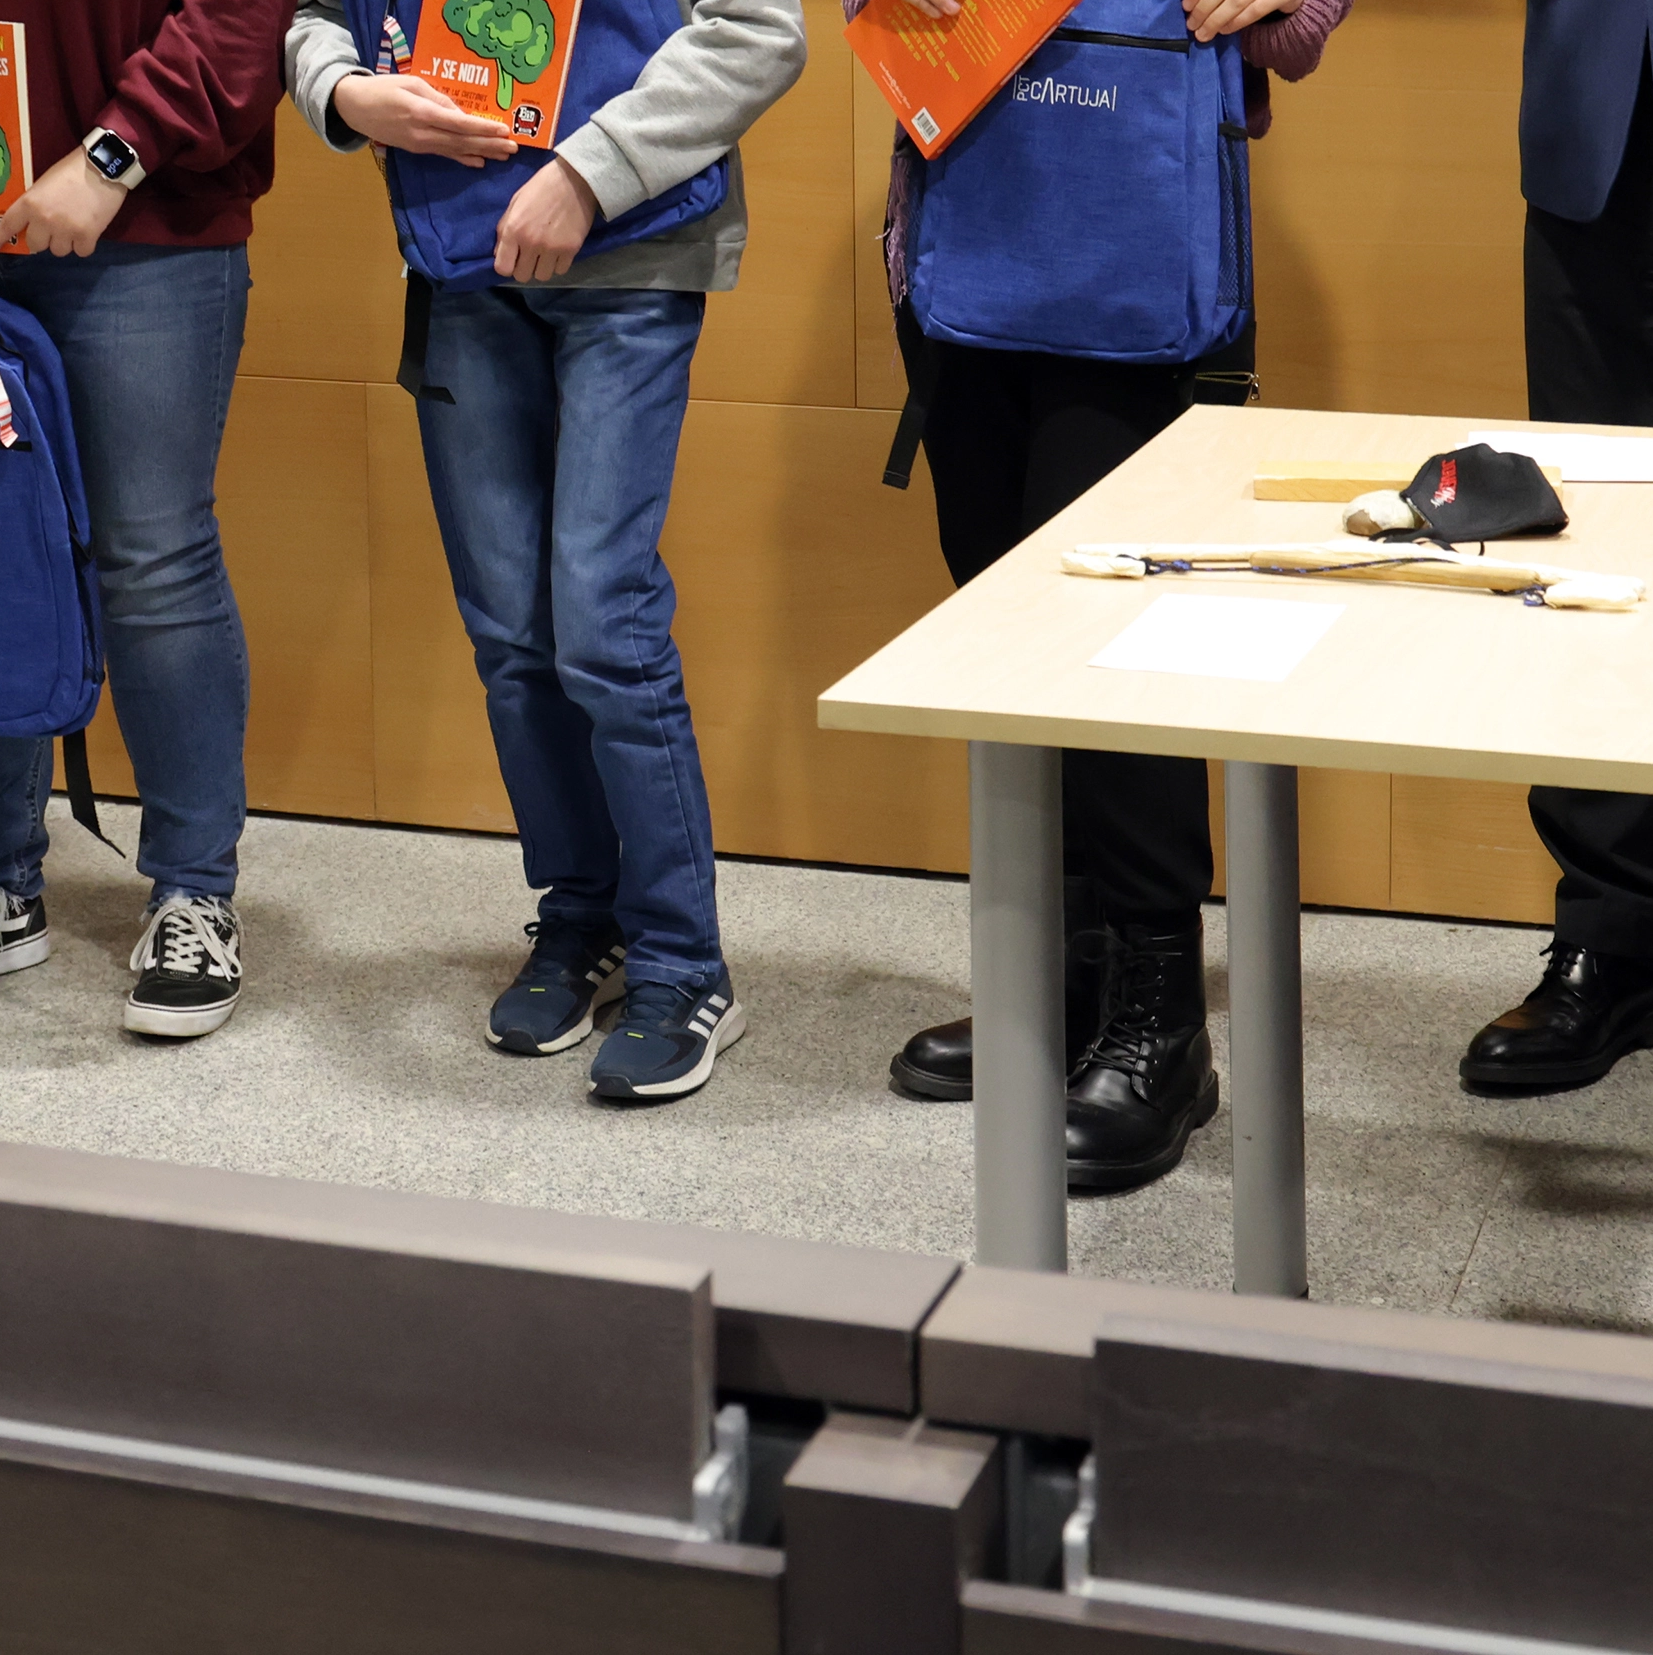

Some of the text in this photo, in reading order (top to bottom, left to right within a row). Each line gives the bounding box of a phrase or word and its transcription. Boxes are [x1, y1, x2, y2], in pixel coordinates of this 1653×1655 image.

[441, 60, 457, 79] SE
[458, 63, 489, 86] NOTA
[1016, 74, 1110, 109] PCT CARTUJA
